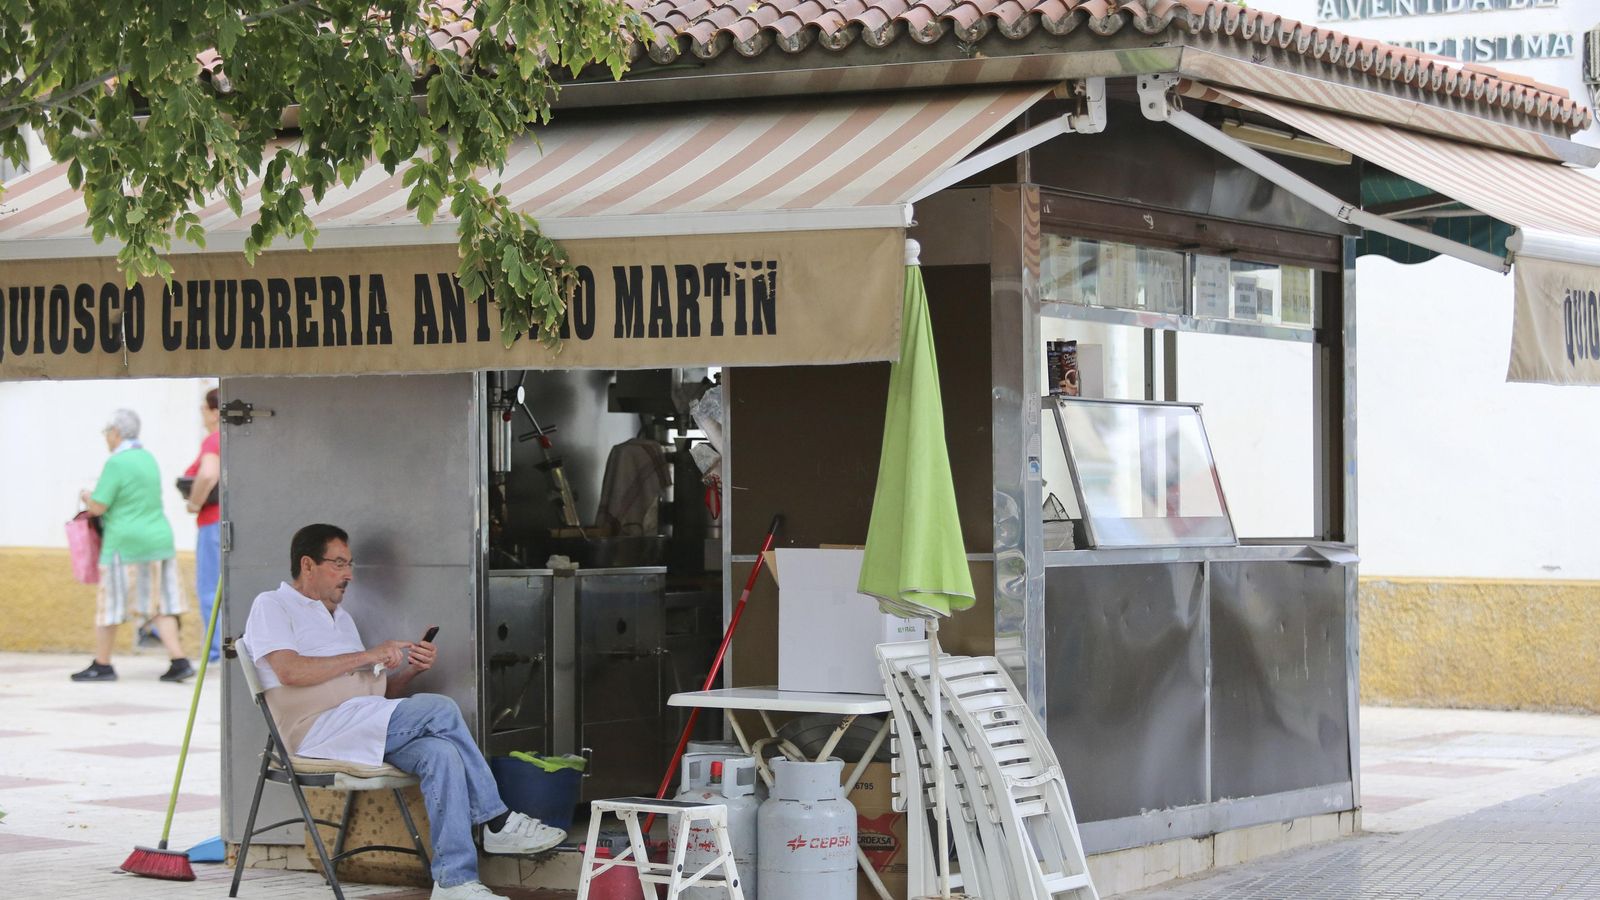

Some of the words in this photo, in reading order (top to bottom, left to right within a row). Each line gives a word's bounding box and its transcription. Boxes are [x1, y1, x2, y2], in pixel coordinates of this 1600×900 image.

[1388, 32, 1574, 60] RISIMA
[0, 282, 145, 363] UIOSCO
[161, 273, 393, 352] CHURRERIA
[413, 264, 596, 345] ANTO
[1564, 288, 1600, 367] QUIO
[853, 782, 874, 790] 6795
